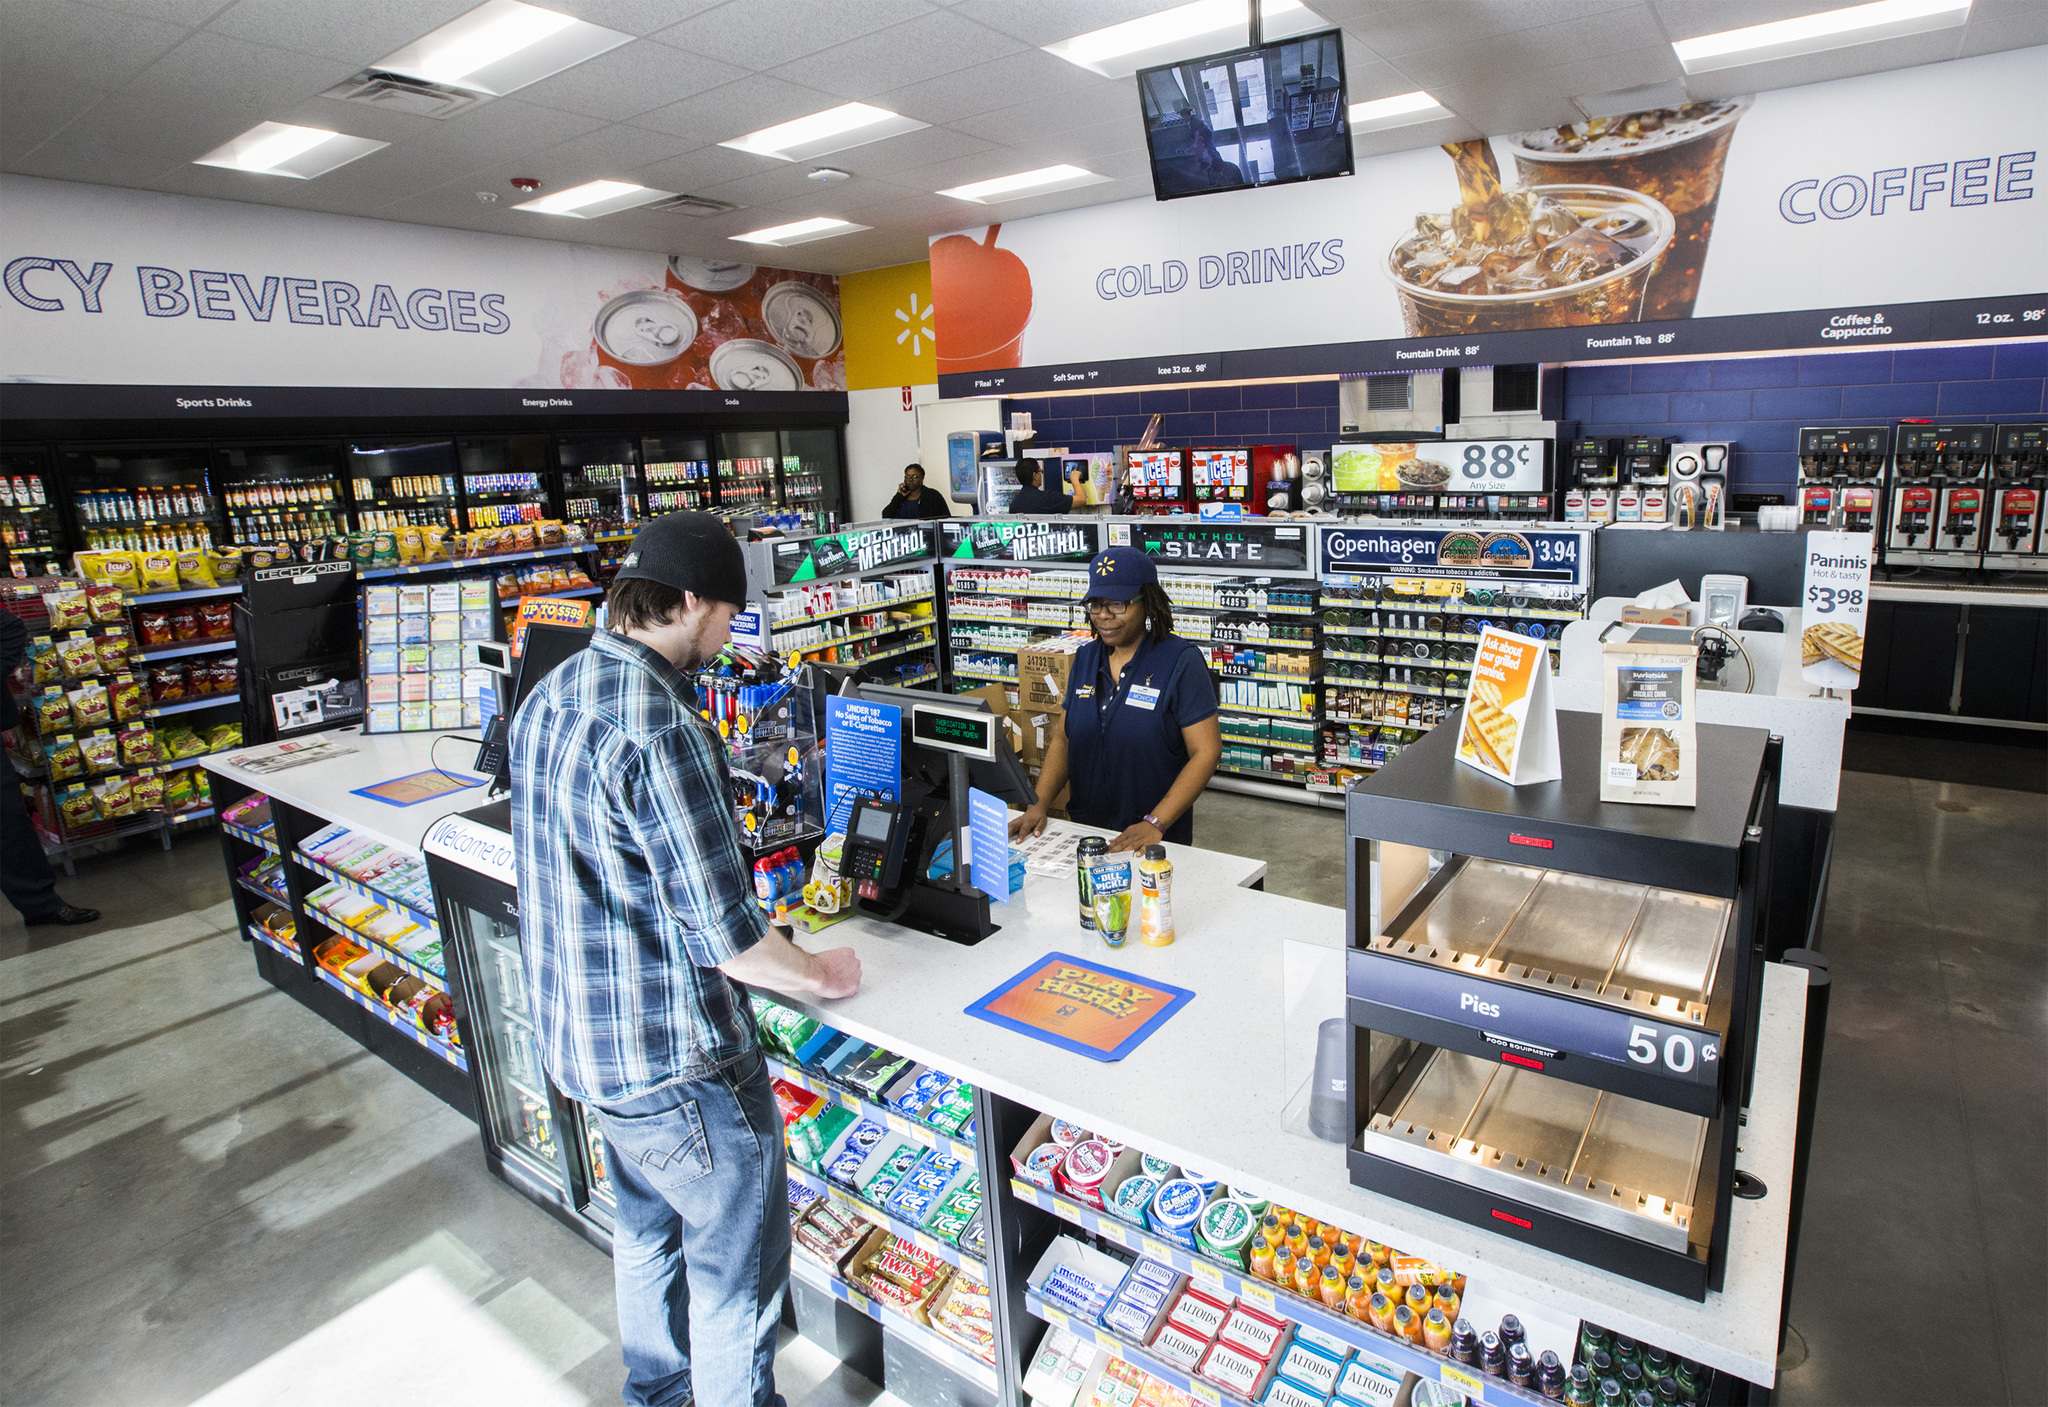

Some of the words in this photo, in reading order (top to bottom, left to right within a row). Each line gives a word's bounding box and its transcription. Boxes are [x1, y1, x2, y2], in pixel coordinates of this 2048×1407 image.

[1779, 151, 2037, 224] COFFEE
[1096, 260, 1188, 300] COLD
[1199, 239, 1345, 290] DRINKS
[3, 256, 113, 313] CY
[137, 266, 511, 334] BEVERAGES
[1830, 315, 1873, 327] Coffee
[1874, 313, 1885, 325] &
[1976, 314, 1989, 324] 12
[1993, 314, 2014, 324] oz.
[2023, 308, 2046, 323] 98¢
[1587, 336, 1632, 349] Fountain
[1633, 335, 1652, 346] Tea
[1658, 332, 1676, 344] 88¢
[1821, 324, 1893, 339] Cappuccino
[1396, 349, 1434, 360] Fountain
[1435, 347, 1461, 358] Drink
[1465, 345, 1480, 356] 88¢
[1053, 373, 1067, 382] Soft
[1067, 371, 1085, 381] Serve
[1158, 365, 1171, 375] Icee
[1172, 365, 1183, 374] 32
[1183, 365, 1192, 374] oz.
[176, 397, 215, 410] Sports
[217, 397, 253, 409] Drinks
[522, 398, 549, 409] Energy
[549, 398, 573, 408] Drinks
[725, 398, 740, 407] Soda
[1146, 461, 1168, 480] ICEE
[1209, 459, 1234, 480] ICEE
[1462, 443, 1531, 480] 88¢
[1469, 481, 1485, 492] Any
[1487, 481, 1506, 491] Size
[848, 527, 893, 550] BOLD
[1002, 522, 1050, 540] BOLD
[1164, 532, 1245, 542] MENTHOL
[858, 530, 927, 572] MENTHOL
[1013, 530, 1088, 561] MENTHOL
[1165, 542, 1262, 560] SLATE
[1327, 531, 1436, 563] Copenhagen
[818, 548, 845, 567] Marlboro
[1810, 552, 1868, 570] Paninis
[1390, 566, 1416, 574] WARNING:
[1417, 567, 1445, 576] Smokeless
[1446, 569, 1467, 577] tobacco
[1474, 570, 1501, 578] addictive.
[1813, 569, 1829, 579] Hot
[1830, 570, 1839, 580] &
[1839, 571, 1863, 582] tasty
[522, 604, 538, 617] UP
[540, 605, 556, 617] TO
[1848, 605, 1862, 614] ea.
[1484, 636, 1499, 650] Ask
[1498, 641, 1524, 657] about
[1481, 651, 1495, 662] our
[1494, 654, 1521, 672] grilled
[1477, 664, 1506, 682] paninis.
[835, 710, 845, 719] No
[844, 712, 860, 722] Sales
[860, 714, 867, 722] of
[867, 715, 892, 727] Tobacco
[846, 704, 869, 716] UNDER
[849, 721, 886, 734] E-Cigarettes
[432, 821, 495, 861] Welcome
[494, 845, 512, 866] to
[1096, 878, 1129, 891] PICKLE
[1101, 871, 1123, 882] DILL
[1057, 967, 1153, 1006] PLAY
[1036, 978, 1141, 1019] HERE!
[1460, 992, 1501, 1019] Pies
[1486, 1036, 1508, 1049] FOOD
[1508, 1041, 1555, 1060] EQUIPMENT
[1627, 1023, 1718, 1074] 50¢
[912, 1171, 947, 1190] ICE
[893, 1190, 930, 1211] ICE
[947, 1192, 982, 1213] ICE
[931, 1214, 966, 1235] ICE
[879, 1250, 923, 1280] TWIX
[1143, 1261, 1173, 1280] ALTOIDS
[1058, 1265, 1097, 1291] mentos
[1045, 1286, 1079, 1308] mentos
[1051, 1277, 1089, 1302] mentos
[1129, 1282, 1160, 1303] ALTOIDS
[1117, 1303, 1148, 1326] ALTOIDS
[1178, 1300, 1218, 1327] ALTOIDS
[1231, 1318, 1273, 1344] ALTOIDS
[1159, 1333, 1200, 1359] ALTOIDS
[1212, 1351, 1255, 1379] ALTOIDS
[1289, 1353, 1333, 1379] ALTOIDS
[1349, 1371, 1394, 1399] ALTOIDS
